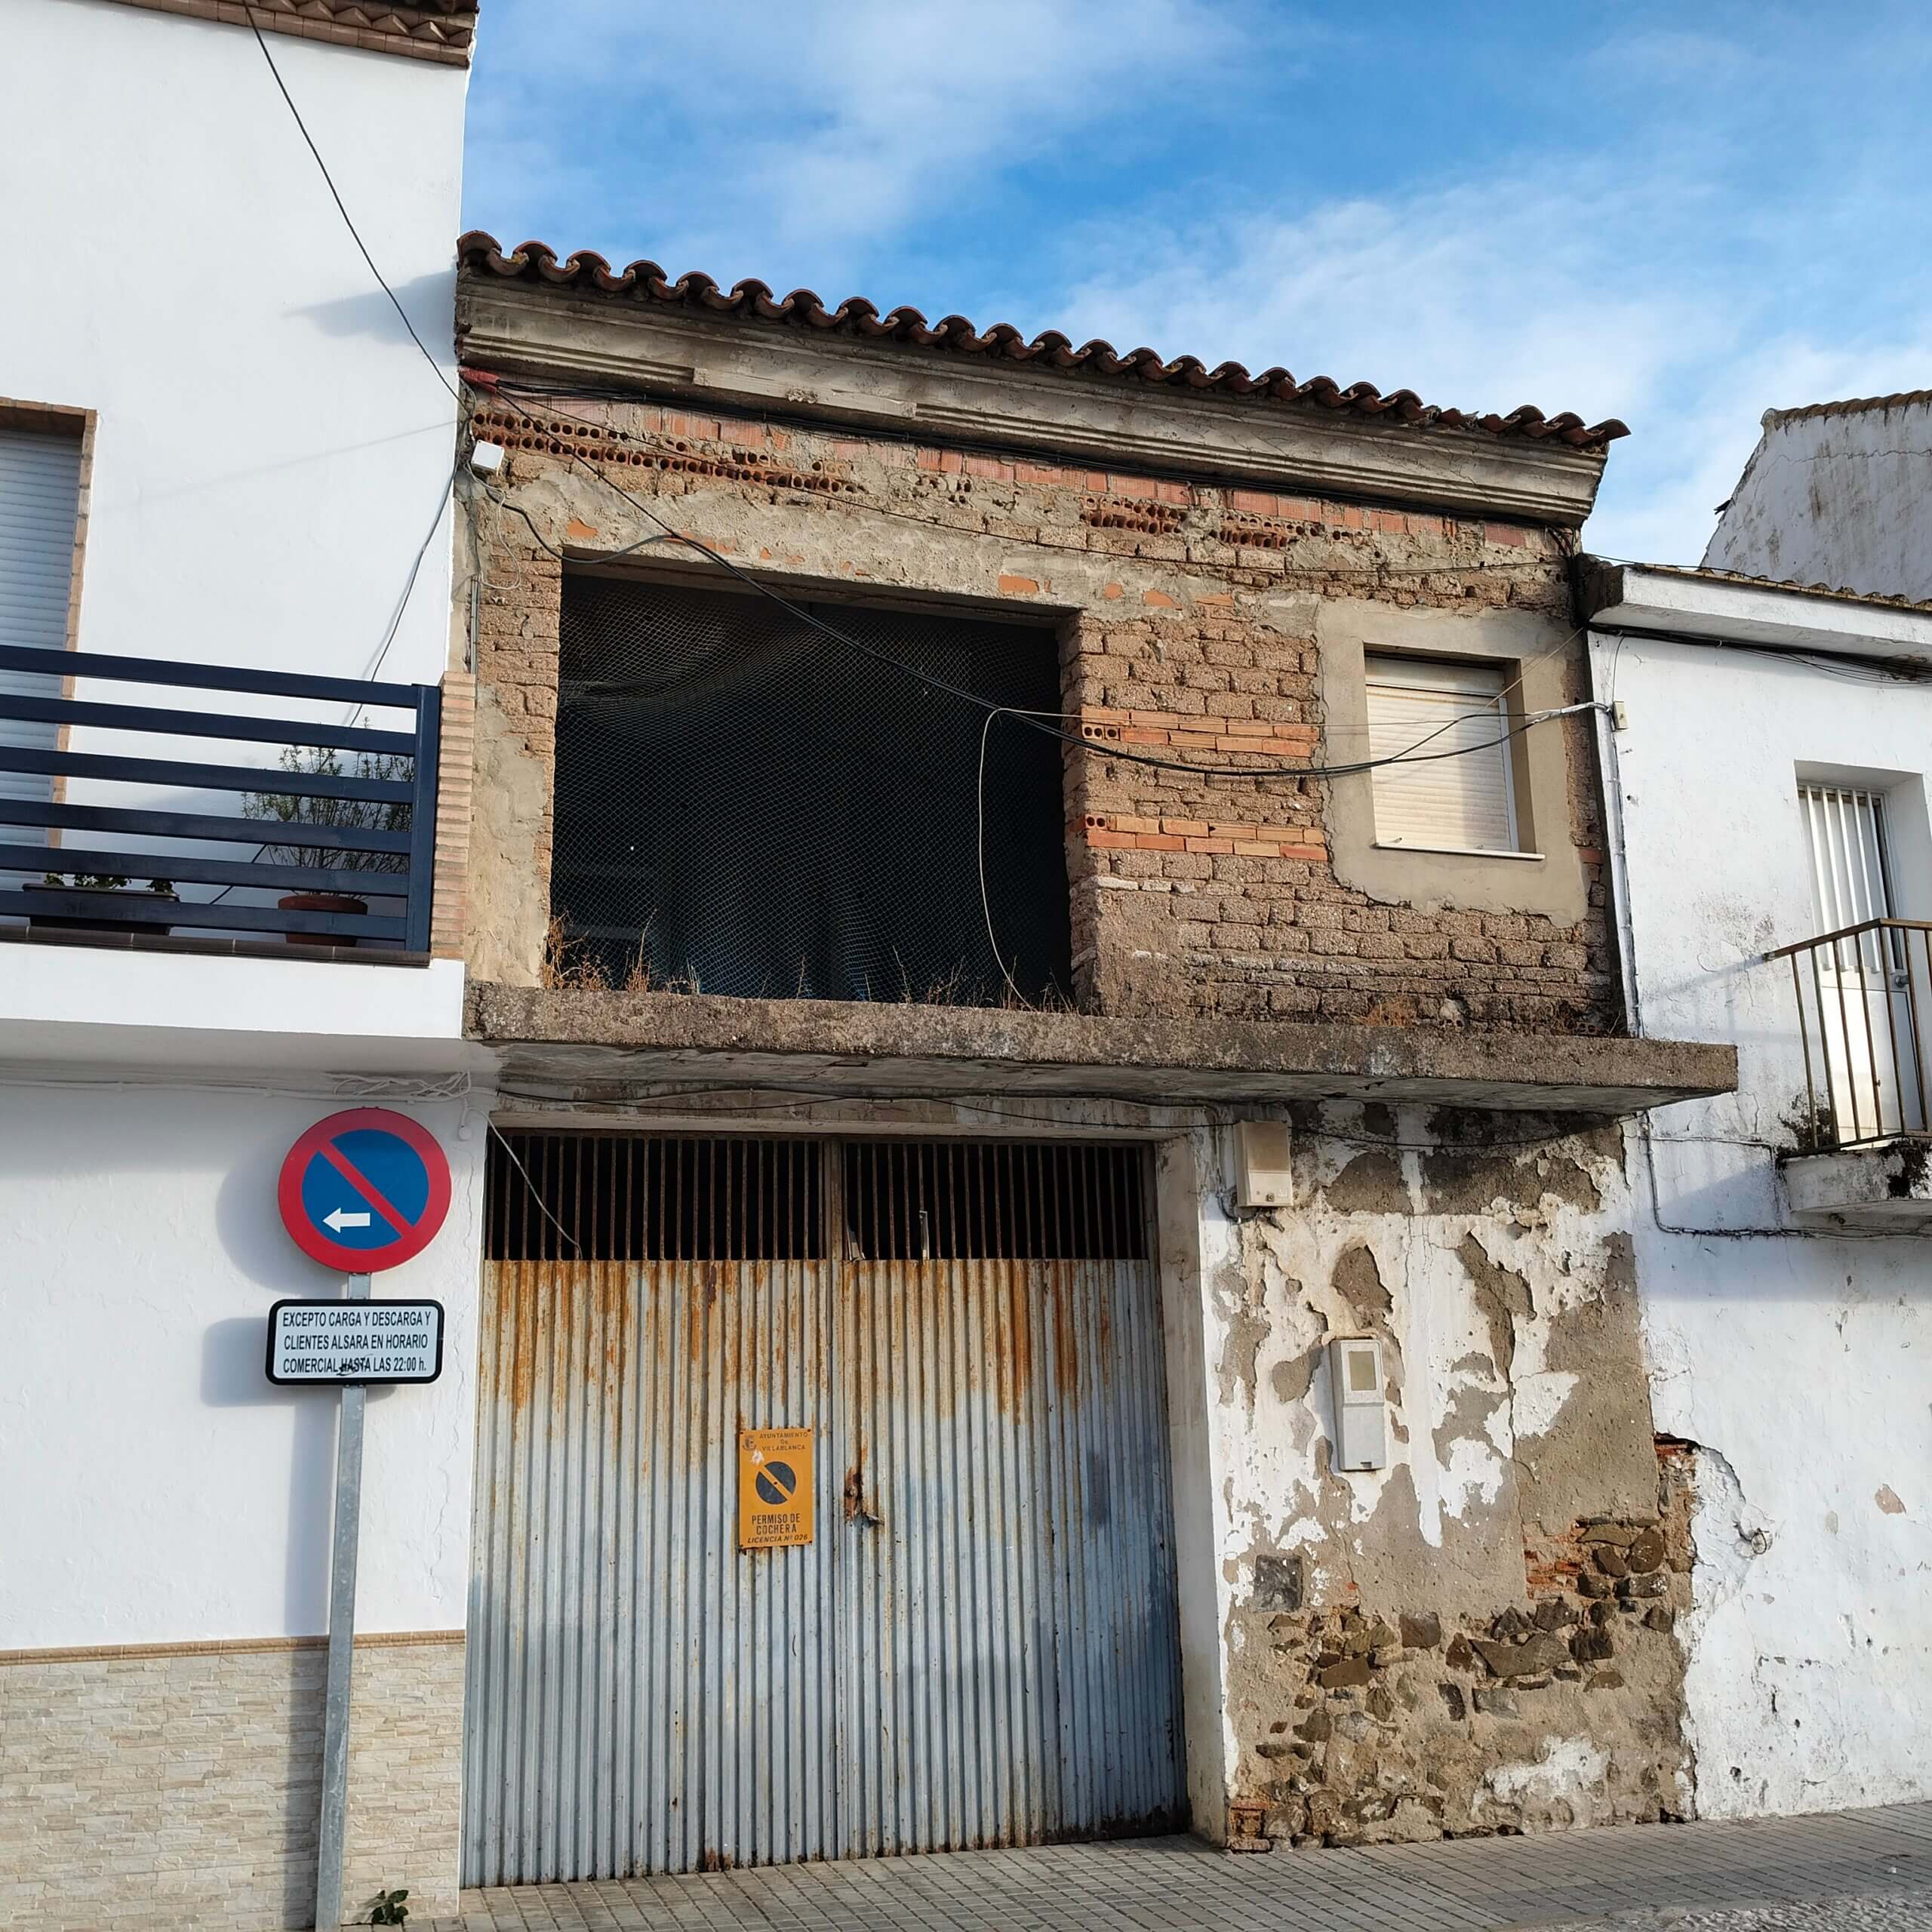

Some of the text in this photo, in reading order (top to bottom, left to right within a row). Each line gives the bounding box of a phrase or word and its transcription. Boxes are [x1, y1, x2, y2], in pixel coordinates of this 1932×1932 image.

[283, 1311, 432, 1327] EXCEPTO CARGA Y DESCARGA Y
[284, 1334, 429, 1350] CLIENTES ALSARA EN HORARIO
[283, 1357, 427, 1374] COMERCIAL HASTA LAS 22:00 h.
[752, 1513, 801, 1524] PERMISO DE
[756, 1523, 797, 1535] COCHERA
